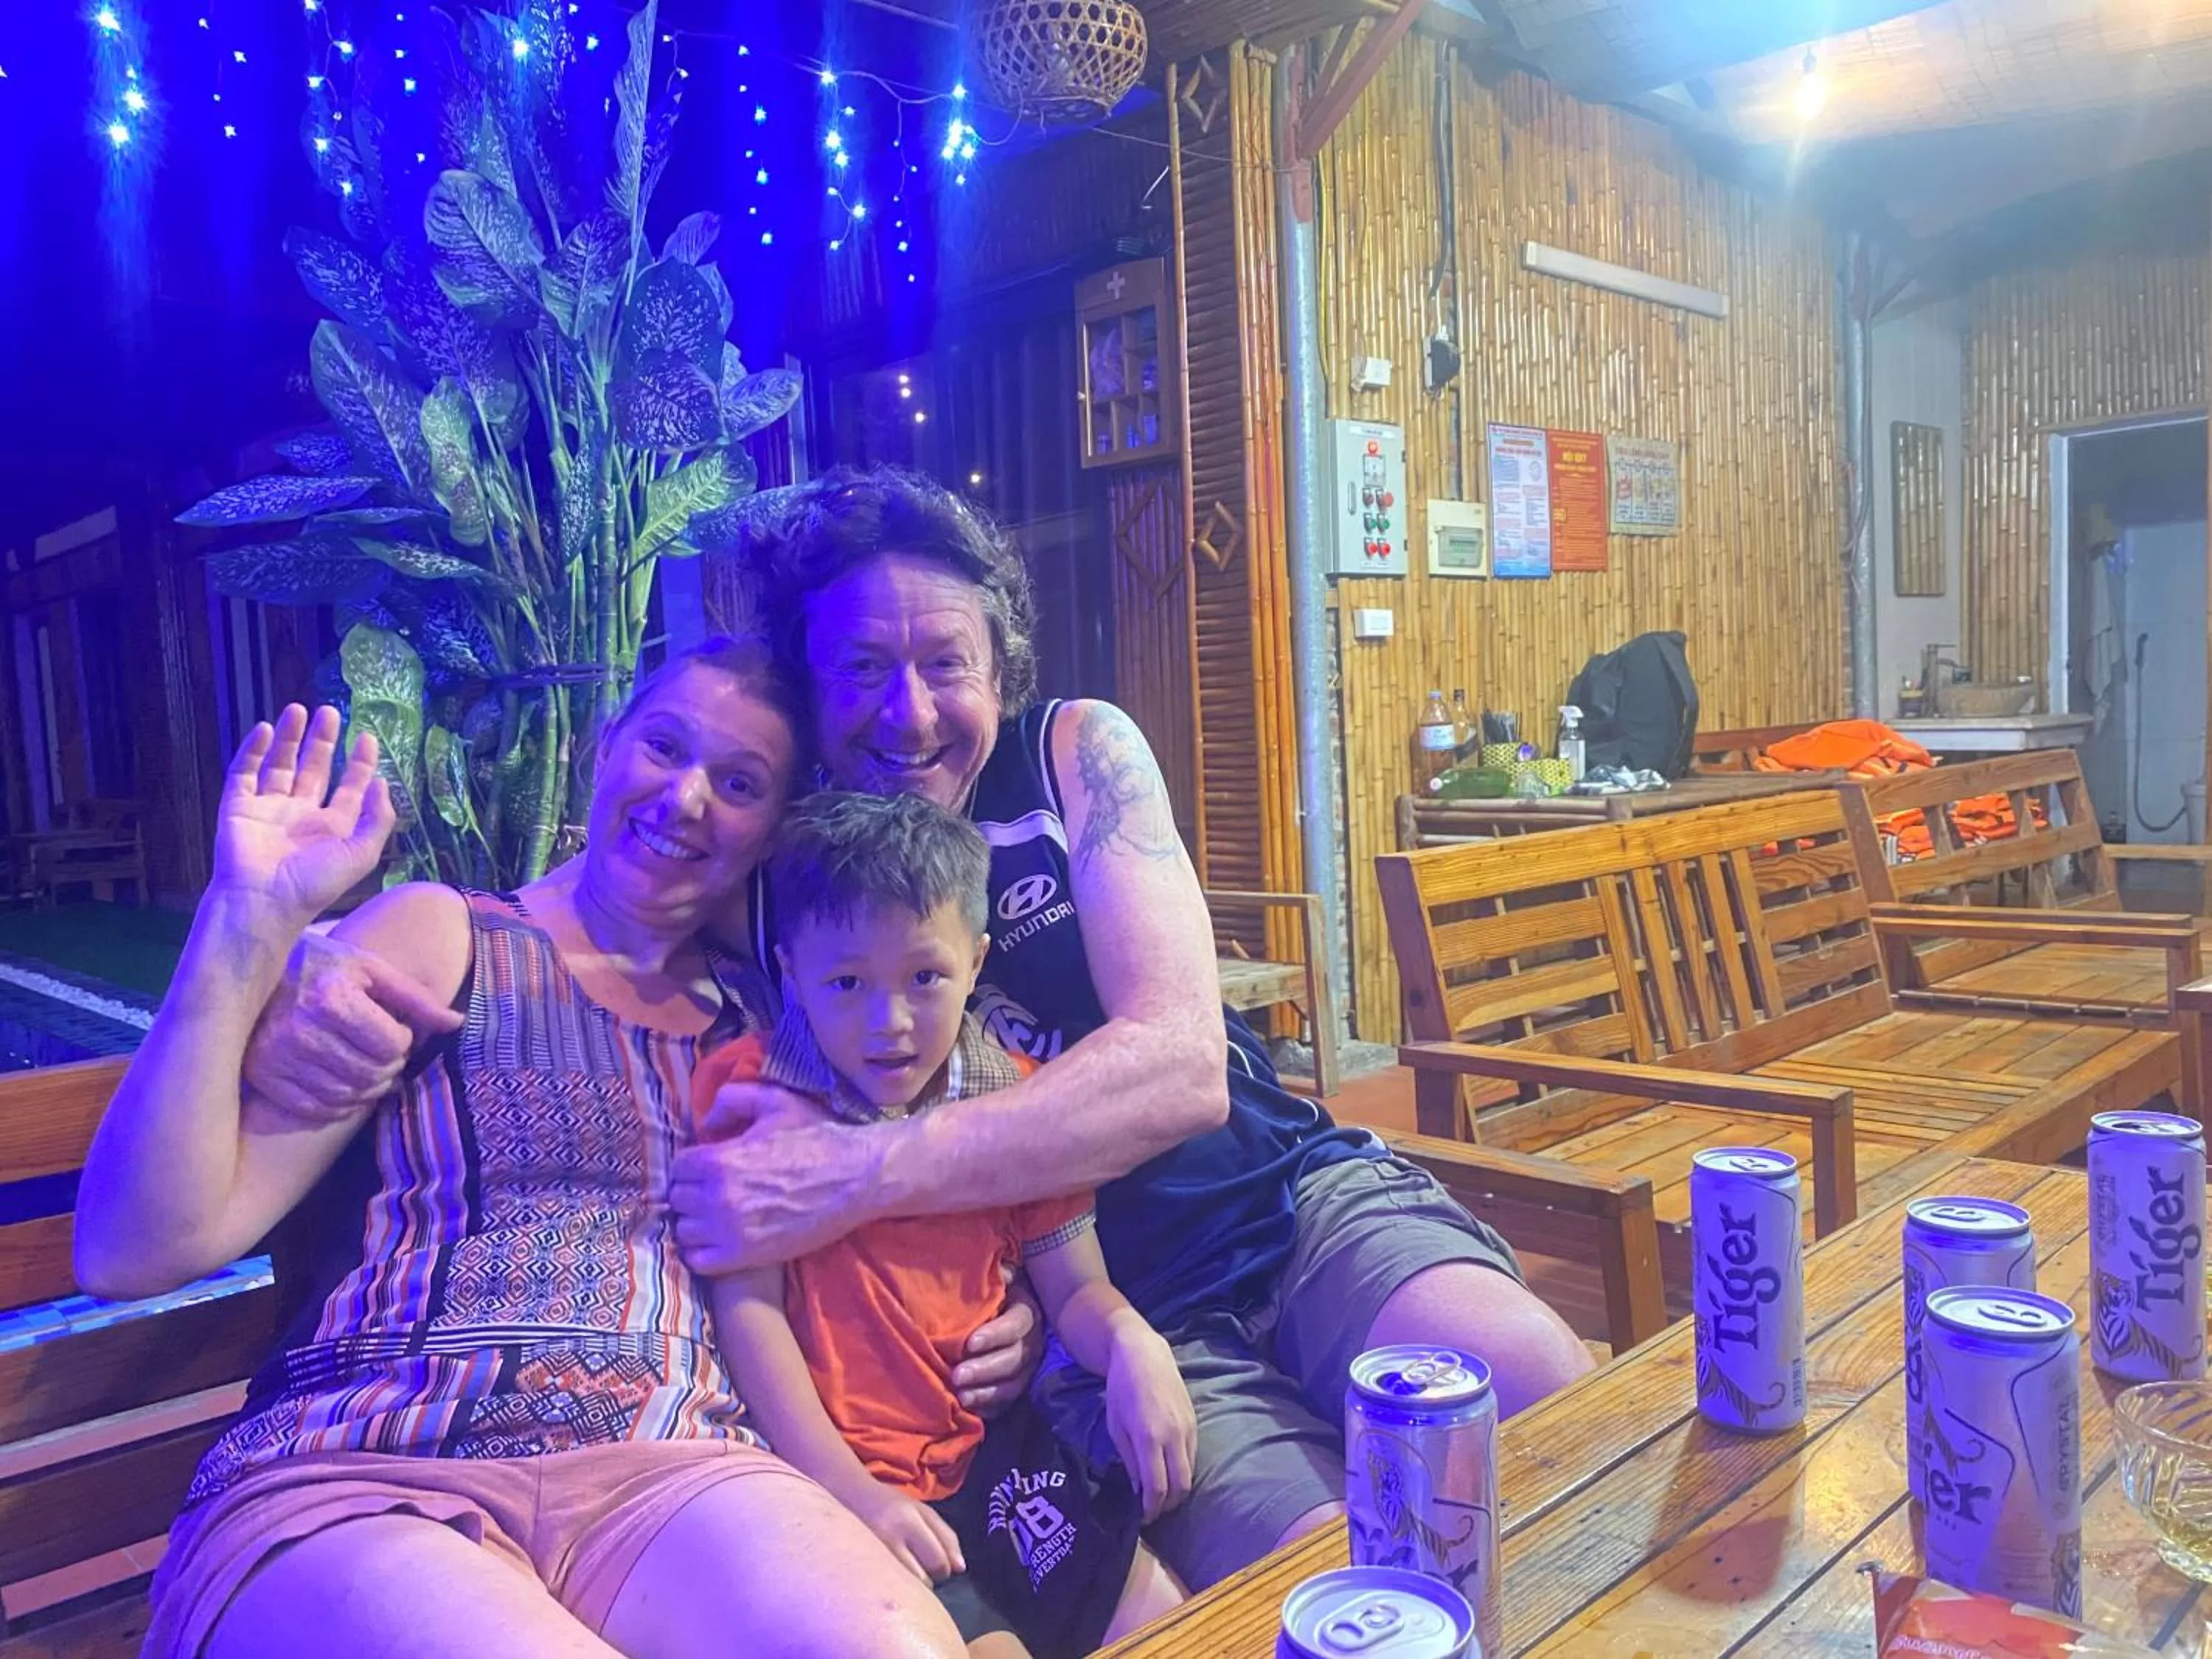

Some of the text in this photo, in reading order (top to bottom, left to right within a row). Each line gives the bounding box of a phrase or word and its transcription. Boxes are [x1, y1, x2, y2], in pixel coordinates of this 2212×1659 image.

[997, 900, 1075, 953] HYUNDAI
[1707, 1203, 1781, 1354] Tiger
[2129, 1165, 2202, 1312] Tiger
